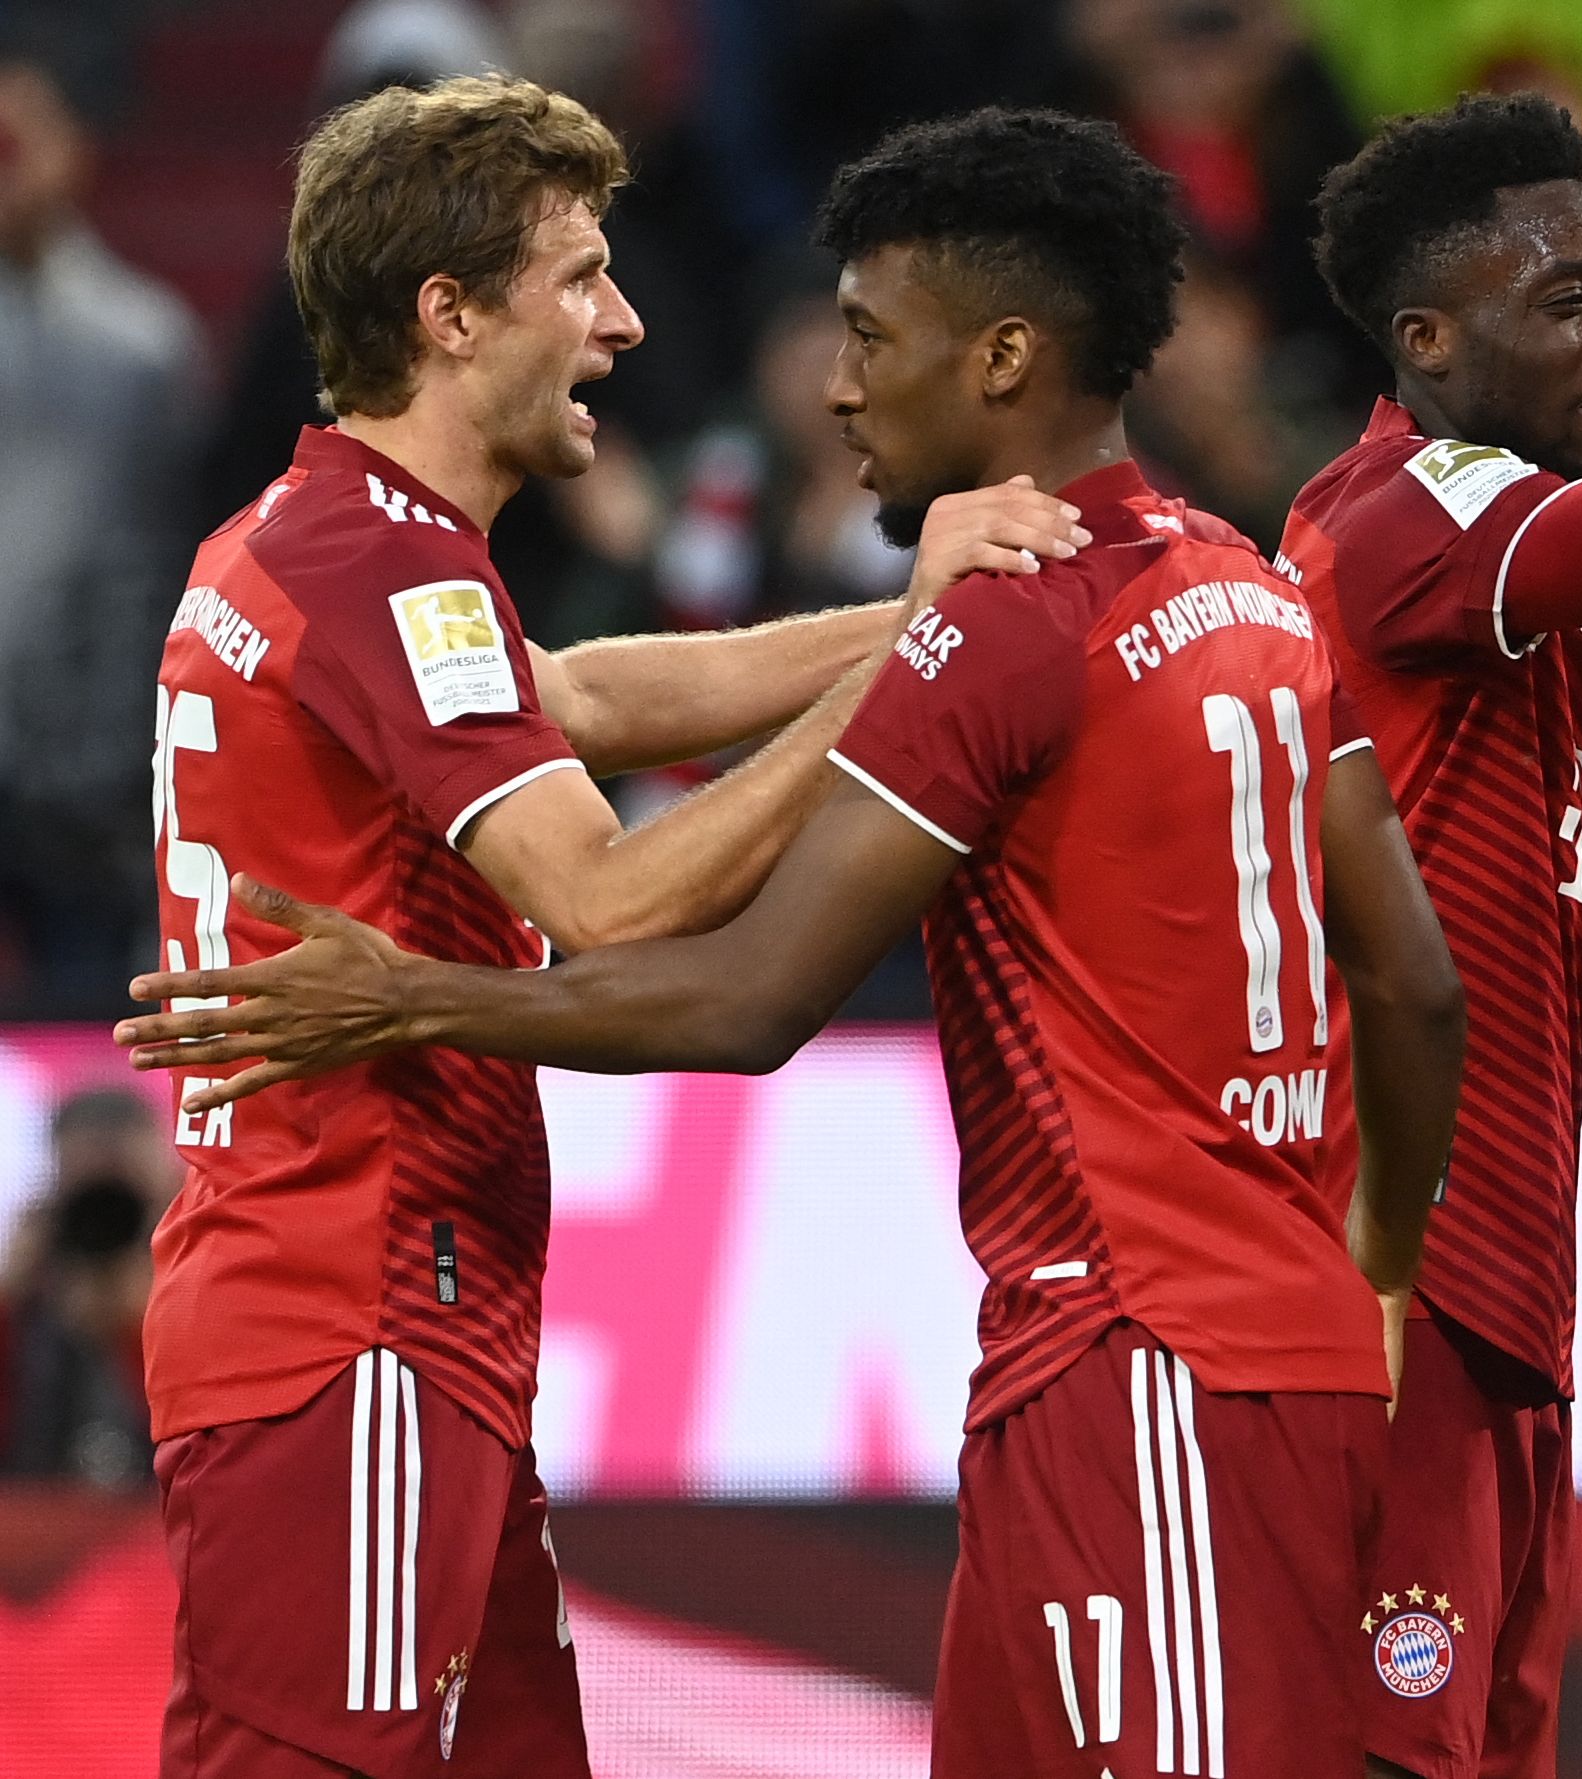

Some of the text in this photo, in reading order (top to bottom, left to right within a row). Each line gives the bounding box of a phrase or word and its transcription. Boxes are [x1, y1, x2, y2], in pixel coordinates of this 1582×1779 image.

[422, 654, 500, 677] BUNDESLIGA
[908, 606, 963, 664] TAR
[1114, 623, 1162, 682] FC
[1150, 581, 1235, 655] BAYERN
[1201, 686, 1329, 1053] 11
[1043, 1594, 1123, 1749] 11
[1380, 1618, 1448, 1651] FC BAYERN
